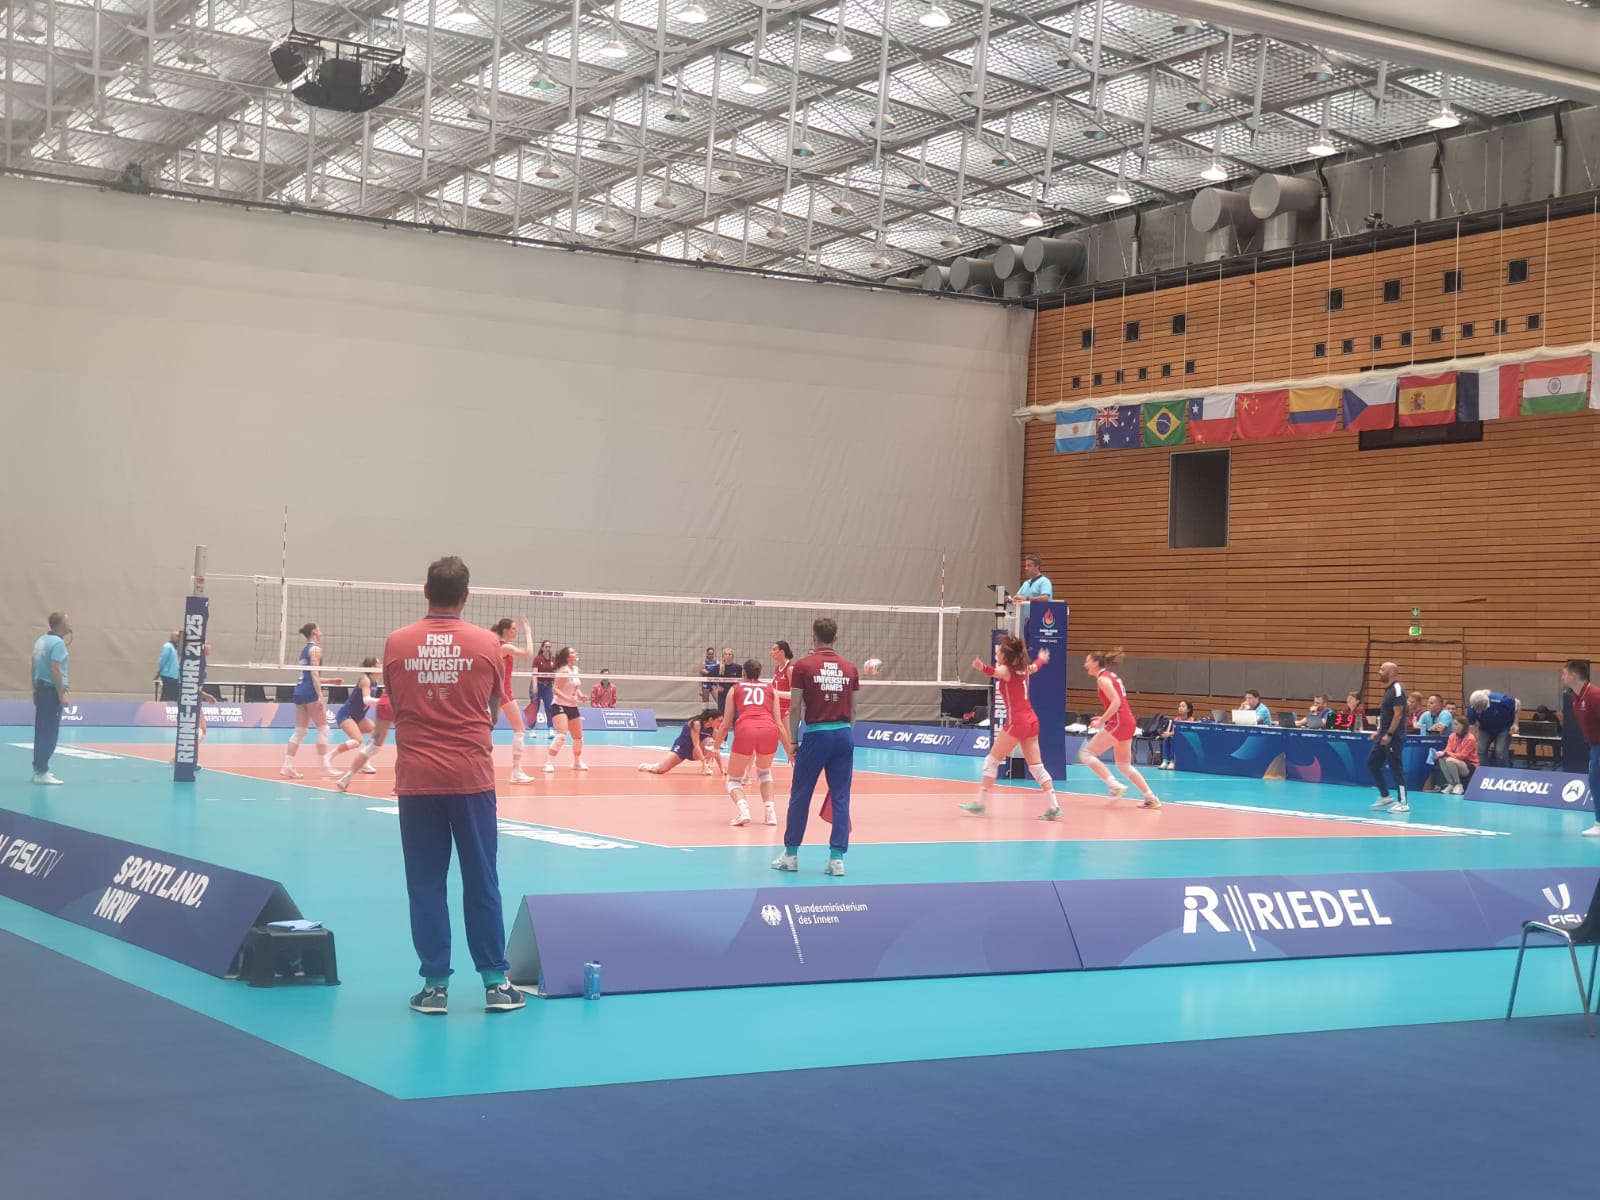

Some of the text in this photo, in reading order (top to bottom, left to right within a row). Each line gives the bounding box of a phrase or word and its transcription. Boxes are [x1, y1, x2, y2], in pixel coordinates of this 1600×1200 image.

[426, 633, 454, 646] FISU
[417, 645, 462, 658] WORLD
[404, 658, 474, 671] UNIVERSITY
[823, 661, 839, 670] FISU
[417, 671, 459, 684] GAMES
[820, 669, 843, 677] WORLD
[813, 676, 851, 685] UNIVERSITY
[820, 684, 844, 692] GAMES
[743, 687, 765, 706] 20
[177, 659, 201, 764] RHINE-RUHR
[867, 729, 893, 741] LIVE
[893, 731, 912, 742] ON
[93, 886, 141, 924] NRW
[794, 901, 869, 914] Bundesministerium
[1247, 888, 1393, 931] RIEDEL
[798, 914, 840, 925] des Innern
